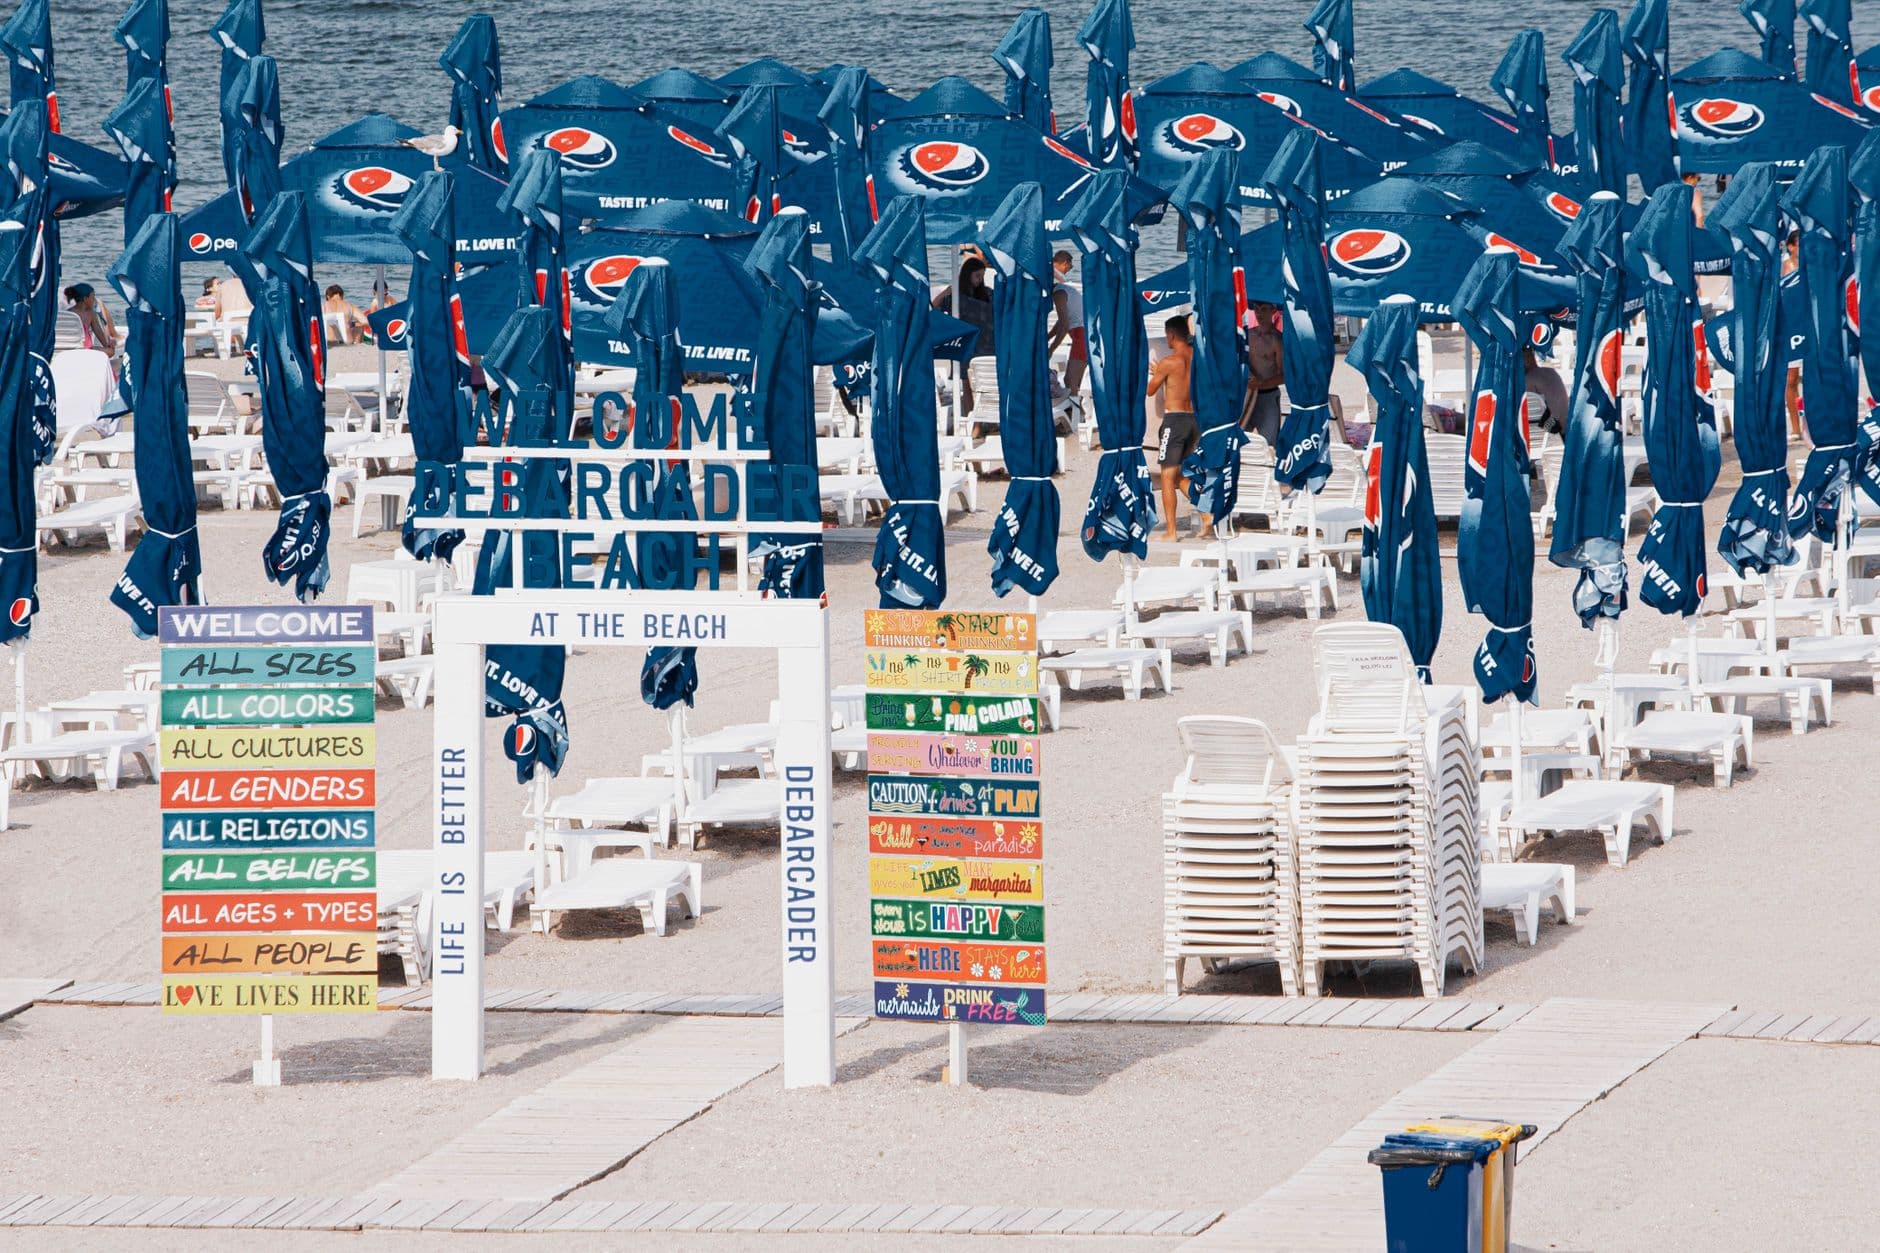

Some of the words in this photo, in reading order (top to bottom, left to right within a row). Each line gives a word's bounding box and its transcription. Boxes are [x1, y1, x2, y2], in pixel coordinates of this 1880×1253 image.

[599, 197, 633, 208] TASTE
[636, 198, 648, 208] IT.
[472, 238, 504, 250] LOVE
[706, 346, 735, 360] LIVE
[736, 348, 750, 362] IT.
[454, 390, 769, 450] WELCOME
[414, 460, 820, 522] DEBARCADER
[523, 532, 720, 591] BEACH
[138, 598, 156, 616] IT.
[170, 612, 363, 636] WELCOME
[530, 612, 560, 637] AT
[576, 613, 625, 638] THE
[644, 614, 727, 640] BEACH
[872, 634, 930, 647] THINKING
[180, 652, 254, 676] ALL
[266, 652, 356, 677] SIZES
[500, 670, 538, 705] LOVE
[868, 673, 908, 686] SHOES
[922, 672, 962, 684] SHIRT
[181, 694, 232, 720] ALL
[241, 694, 354, 719] COLORS
[978, 698, 1034, 724] COLADA
[172, 739, 223, 760] ALL
[232, 736, 364, 759] CULTURES
[928, 744, 982, 770] Whatever
[992, 740, 1018, 756] YOU
[990, 758, 1033, 774] BRING
[172, 778, 222, 802] ALL
[230, 776, 364, 801] GENDERS
[442, 748, 466, 844] BETTER
[978, 782, 994, 800] at
[994, 789, 1038, 813] PLAY
[168, 819, 214, 842] ALL
[222, 818, 368, 841] RELIGIONS
[974, 836, 1034, 854] paradise
[168, 858, 236, 882] ALL
[246, 858, 370, 884] BELIEFS
[785, 766, 816, 964] DEBARCADER
[963, 862, 993, 878] MAKE
[440, 871, 464, 894] IS
[920, 866, 961, 892] LIMES
[970, 872, 1032, 898] margaritas
[166, 904, 208, 924] ALL
[215, 902, 276, 922] AGES
[283, 908, 294, 920] +
[302, 902, 373, 922] TYPES
[908, 904, 926, 931] is
[930, 904, 1002, 935] HAPPY
[173, 942, 242, 966] ALL
[254, 942, 366, 966] PEOPLE
[440, 921, 464, 974] LIFE
[966, 946, 1008, 965] STAYS
[236, 984, 298, 1006] LIVES
[312, 984, 370, 1006] HERE
[878, 988, 940, 1016] mermaids
[944, 988, 994, 1006] DRINK
[968, 1003, 1017, 1021] FREE
